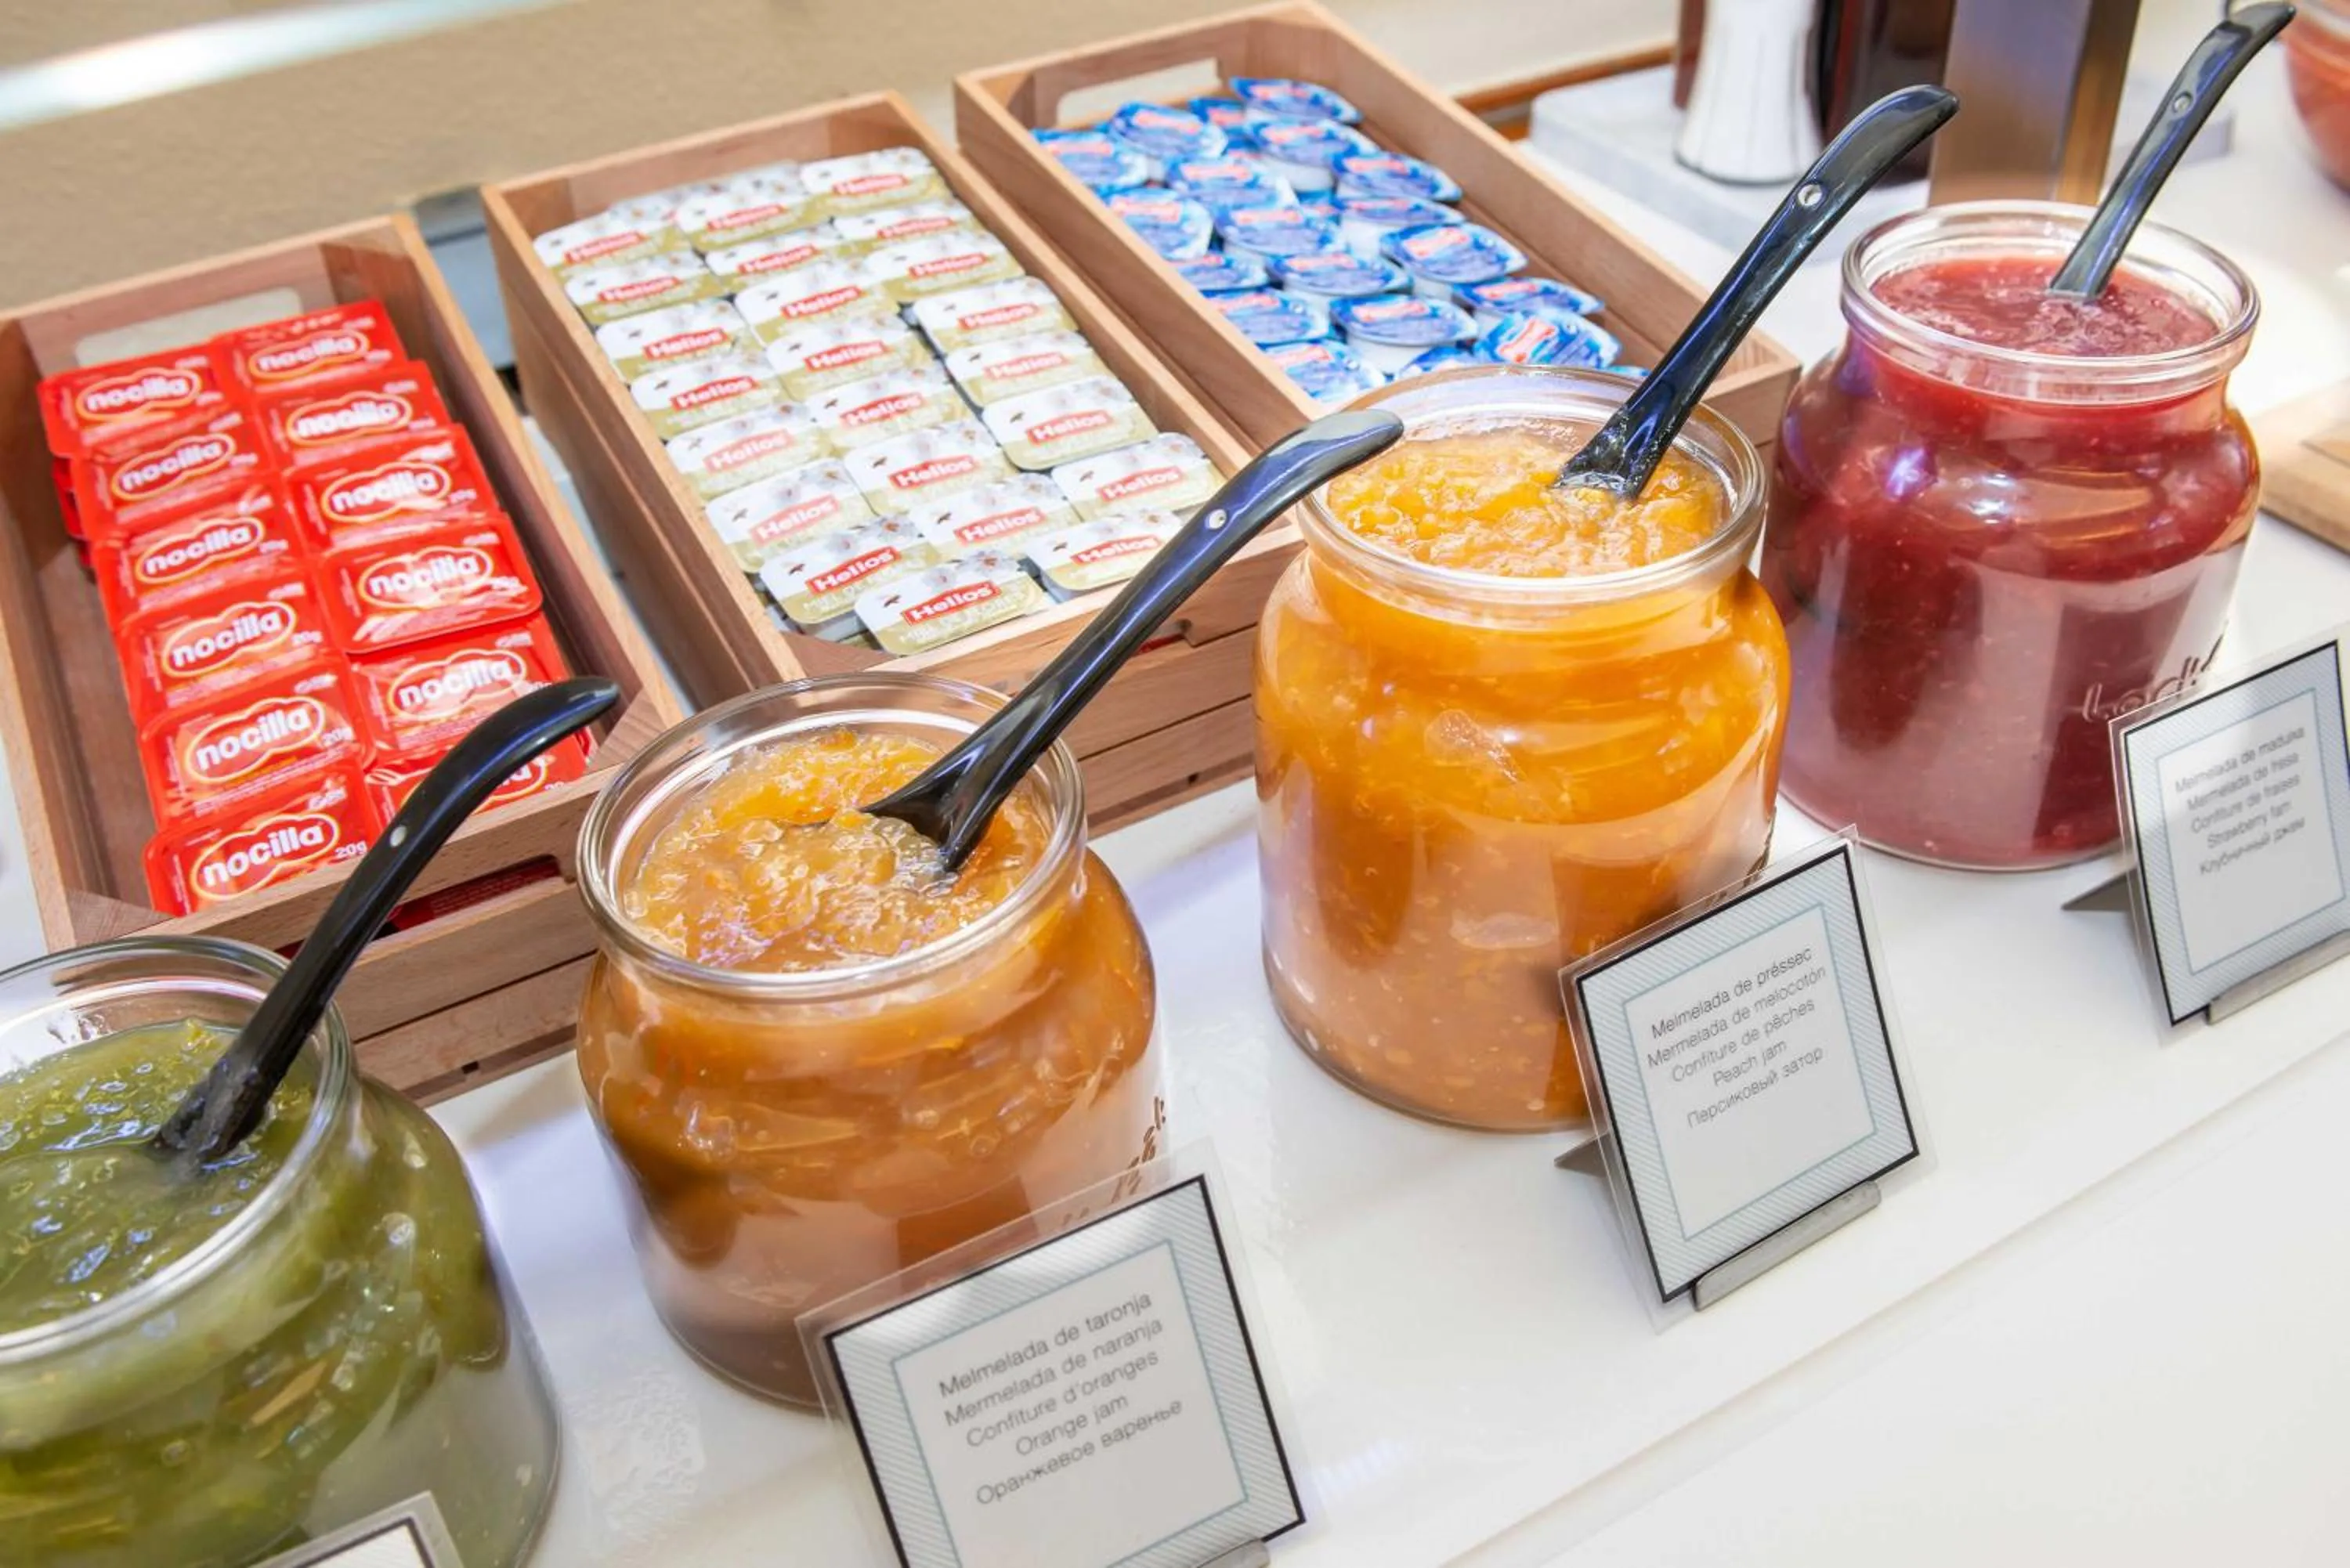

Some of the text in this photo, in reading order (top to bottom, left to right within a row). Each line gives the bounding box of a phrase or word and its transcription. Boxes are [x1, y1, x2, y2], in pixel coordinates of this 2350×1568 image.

[812, 343, 885, 368] Helios
[675, 378, 754, 407] Helios
[845, 394, 922, 426] Helios
[710, 432, 789, 468] Helios
[1032, 412, 1108, 441] Helios
[121, 443, 222, 490] nocilla
[896, 457, 974, 486] Helios
[1103, 468, 1180, 497] Helios
[331, 471, 438, 512] nocilla
[756, 500, 833, 540] Helios
[962, 511, 1039, 542] Helios
[145, 527, 251, 574] nocilla
[814, 550, 894, 591] Helios
[1078, 537, 1158, 562] Helios
[369, 555, 479, 594] nocilla
[911, 584, 993, 621] Helios
[172, 612, 282, 667] nocilla
[398, 660, 513, 708] nocilla
[196, 707, 311, 771] nocilla
[203, 826, 324, 887] nocilla
[334, 840, 367, 858] 20g
[1647, 966, 1827, 1068] Mermelada de melocotón
[1650, 948, 1813, 1039] Melmelada de préssec
[1671, 999, 1816, 1082] Confiture de pêches
[1712, 1039, 1788, 1086] Peach jam
[1686, 1046, 1824, 1129] Персиковый затор
[939, 1293, 1152, 1399] Melmelada de taronja
[944, 1318, 1163, 1427] Mermelada de naranja
[966, 1396, 1058, 1447] Confiture
[1016, 1395, 1129, 1455] Orange jam
[976, 1400, 1183, 1505] Оранжевое варенье
